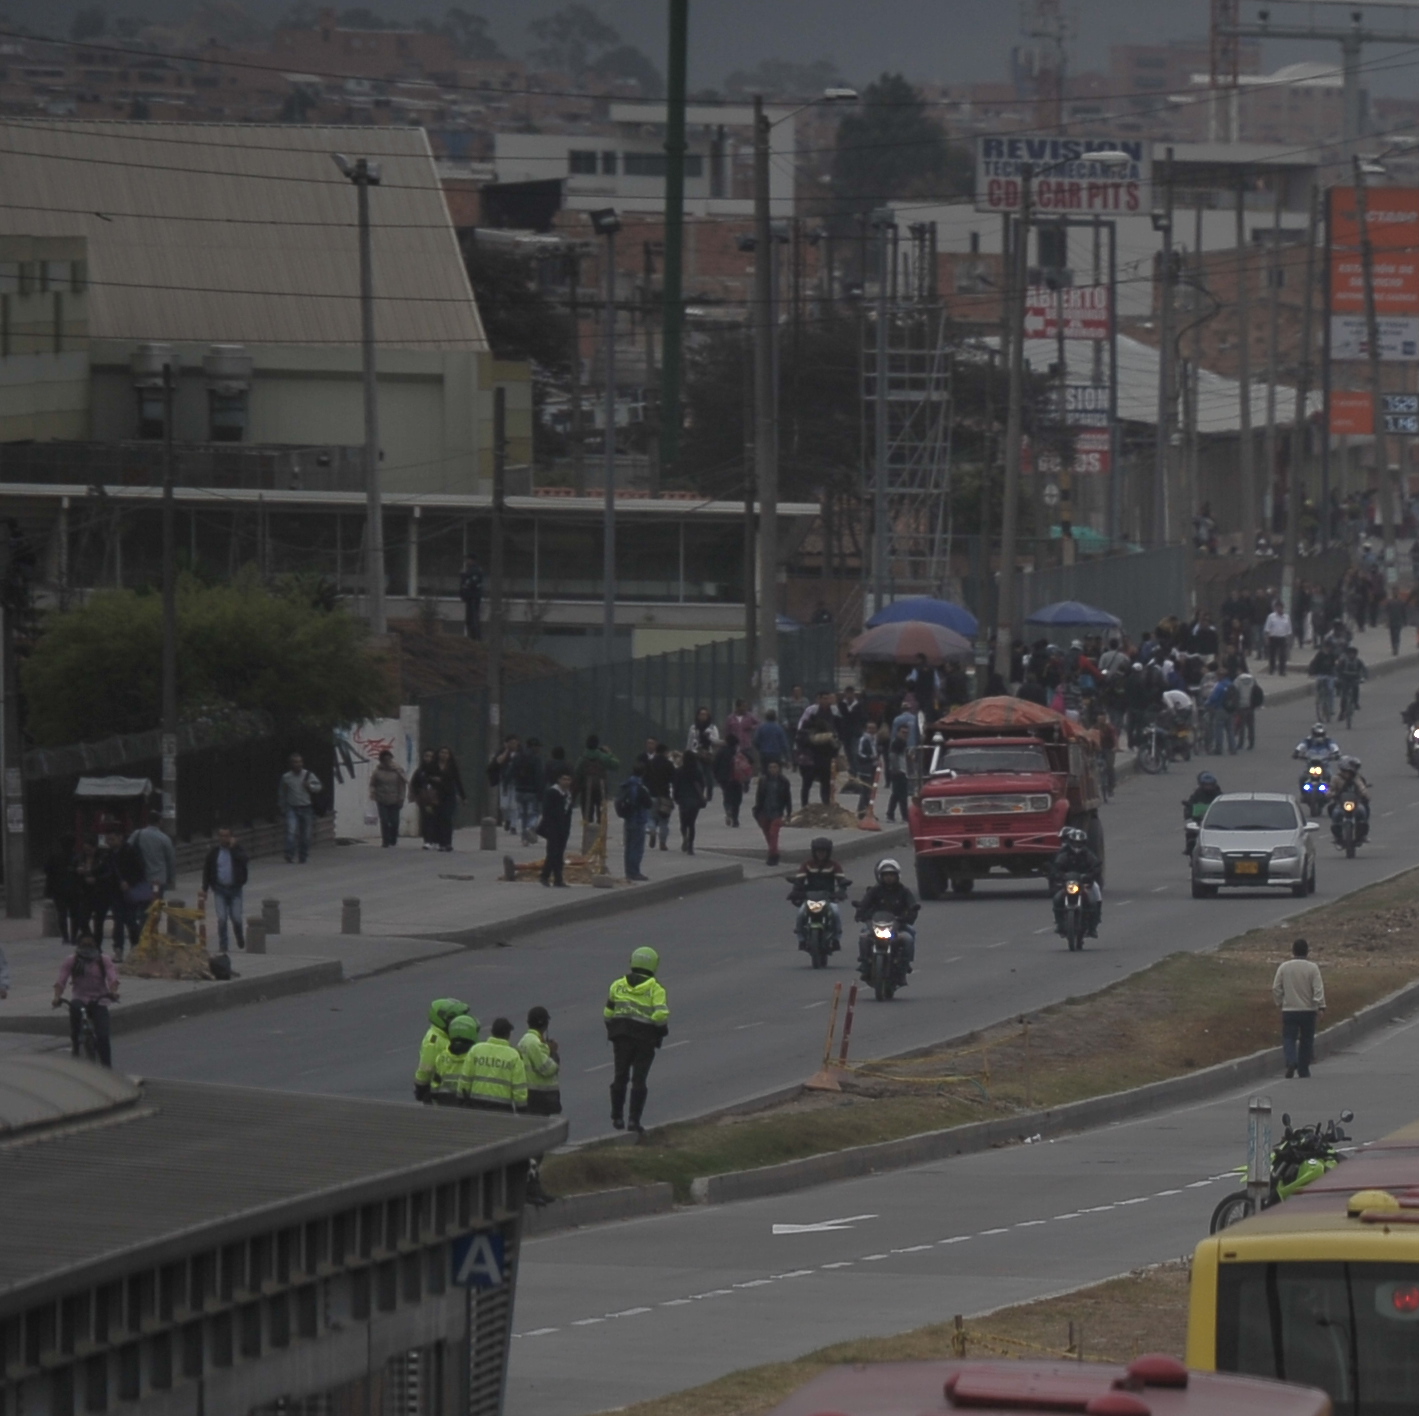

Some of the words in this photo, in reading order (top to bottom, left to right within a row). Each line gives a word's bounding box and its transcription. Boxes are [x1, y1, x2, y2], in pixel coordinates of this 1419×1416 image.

[1038, 180, 1082, 208] CAR
[1087, 181, 1140, 211] PITS
[473, 1055, 516, 1071] POLICIA
[456, 1234, 503, 1285] A
